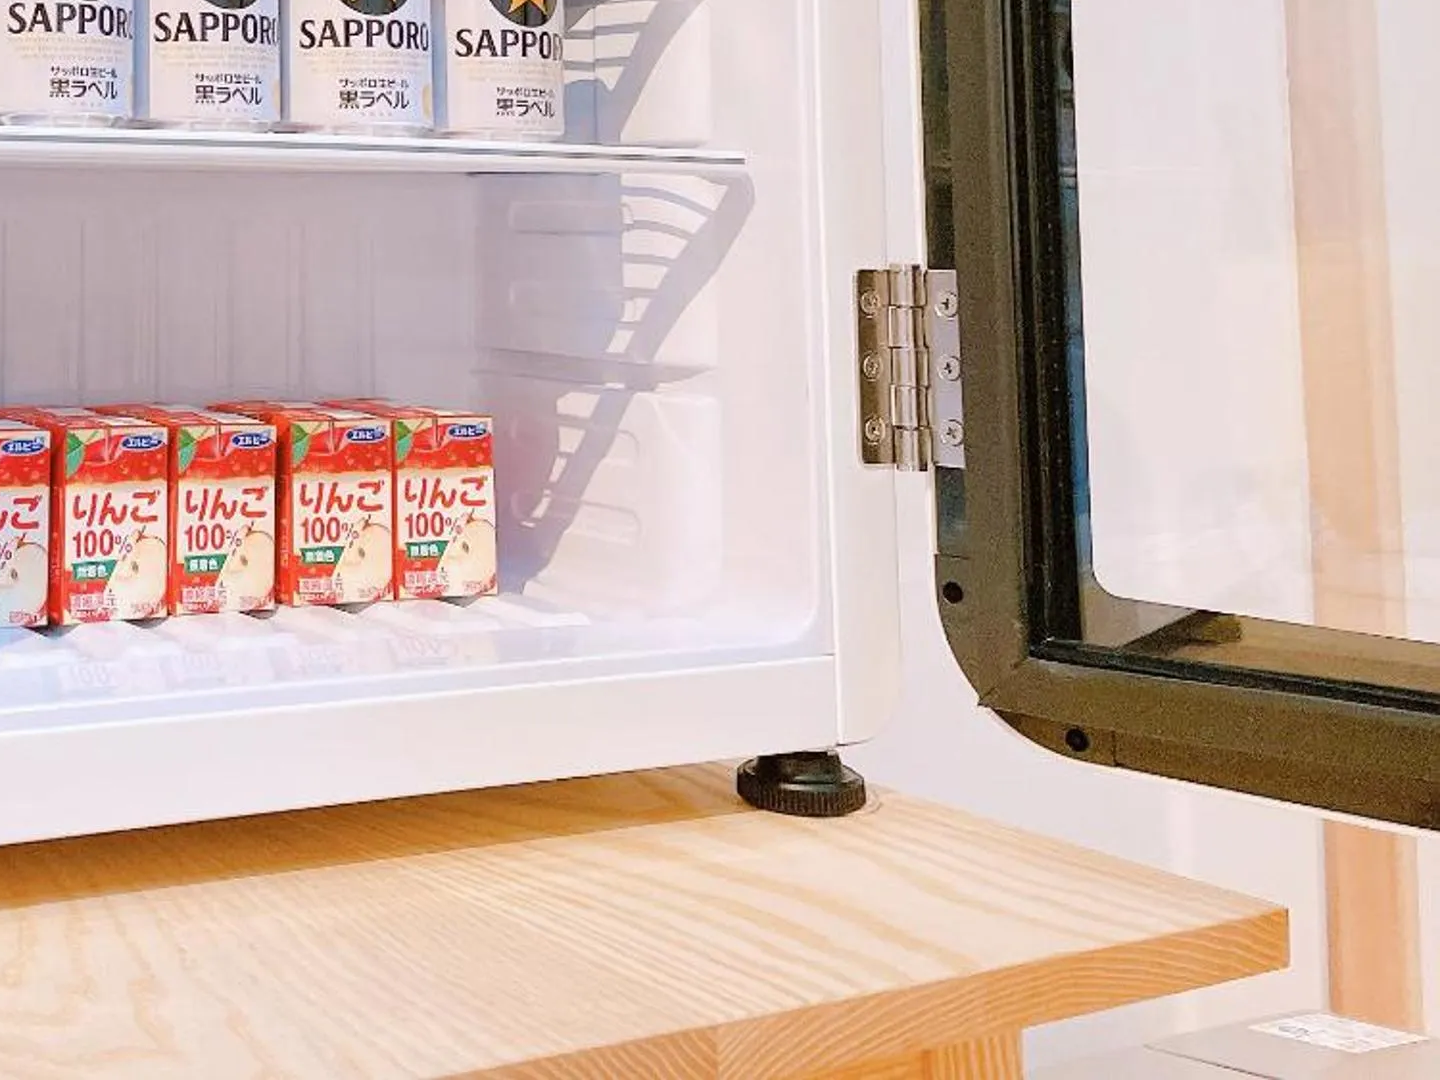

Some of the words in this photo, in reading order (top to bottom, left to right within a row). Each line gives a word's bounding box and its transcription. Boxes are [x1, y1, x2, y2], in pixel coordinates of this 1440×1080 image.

[299, 19, 429, 52] SAPPORO
[49, 78, 118, 100] 黒ラベル
[195, 85, 262, 105] 黒ラベル
[339, 90, 410, 109] 黒ラベル
[496, 98, 556, 119] 黒ラベル
[185, 486, 269, 521] りんご
[300, 480, 385, 514] りんご
[404, 476, 488, 509] りんご
[73, 490, 161, 527] りんご
[184, 523, 242, 552] 100%
[301, 516, 360, 544] 100%
[404, 511, 464, 539] 100%
[72, 528, 132, 558] 100%
